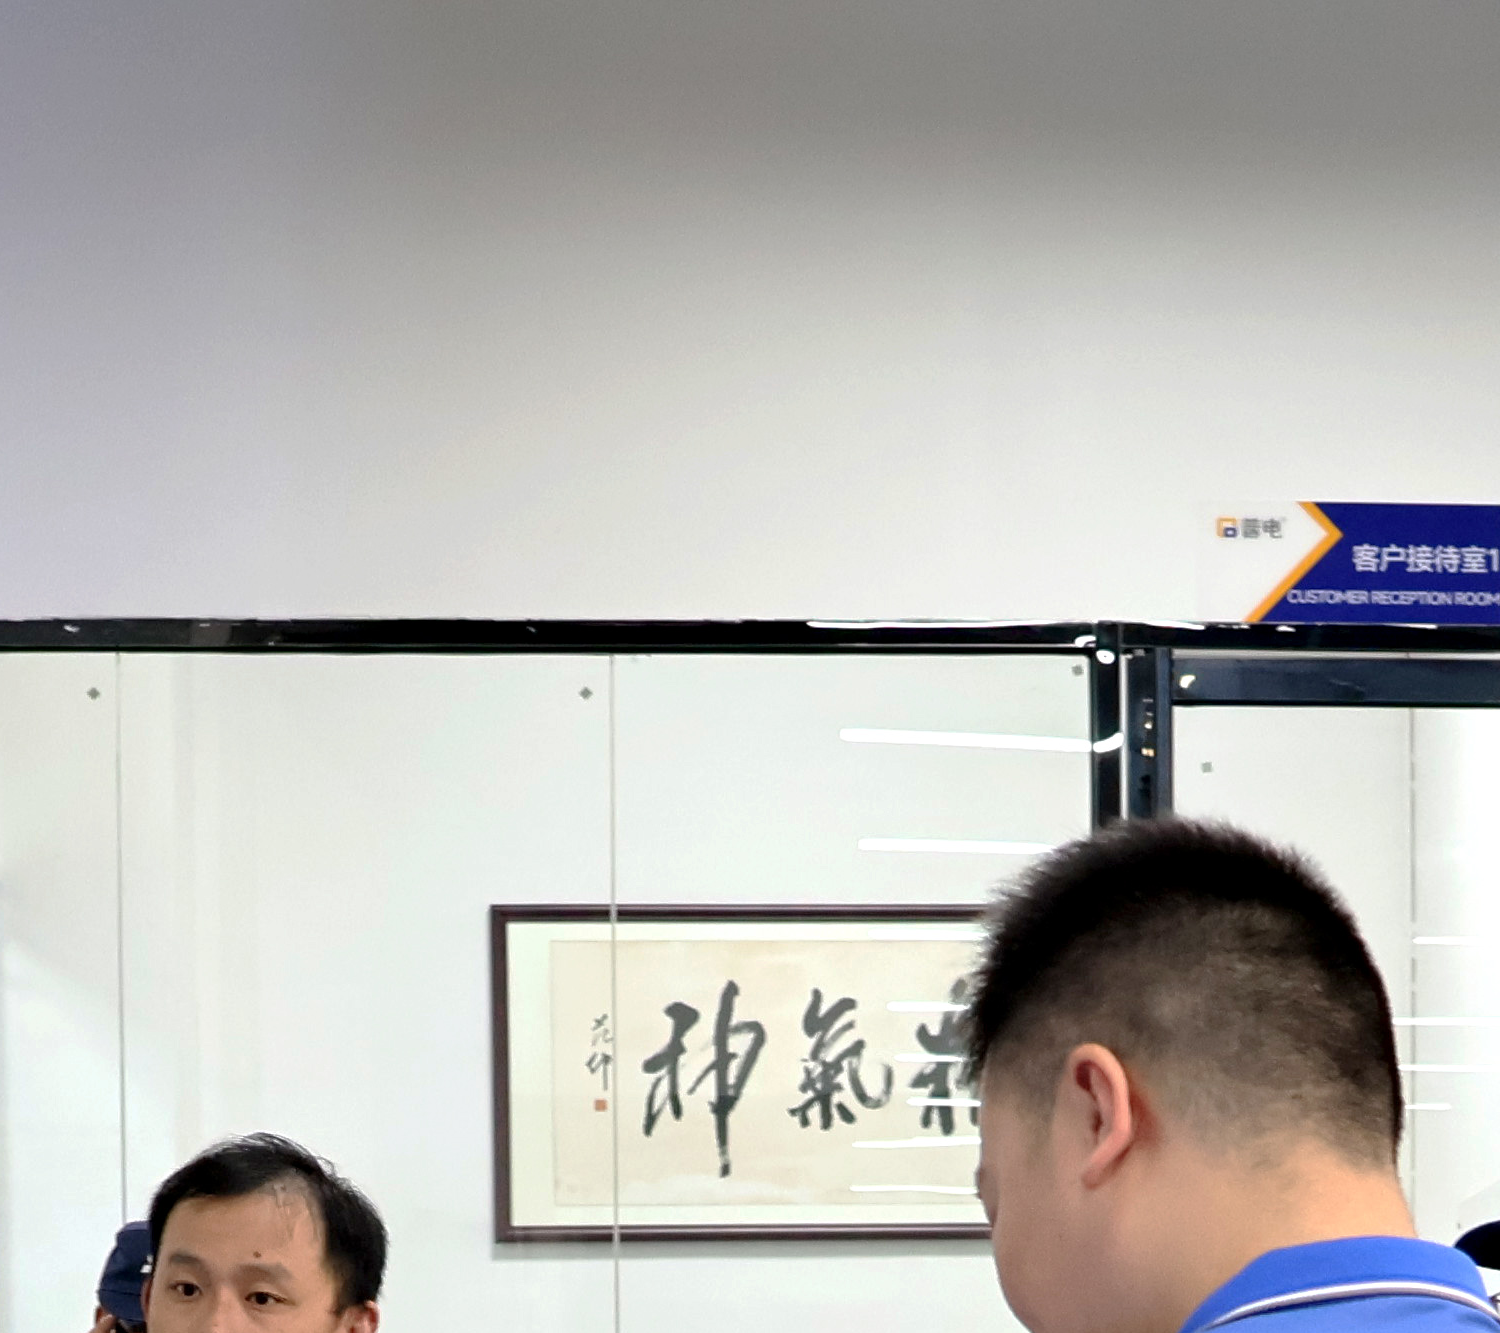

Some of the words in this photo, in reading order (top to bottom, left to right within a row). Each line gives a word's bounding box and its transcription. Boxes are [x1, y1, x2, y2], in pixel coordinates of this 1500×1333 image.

[1352, 544, 1500, 573] 客户接待室1
[1286, 589, 1369, 605] CUSTOMER
[1371, 589, 1452, 606] RECEPTION
[1454, 591, 1500, 607] ROOM
